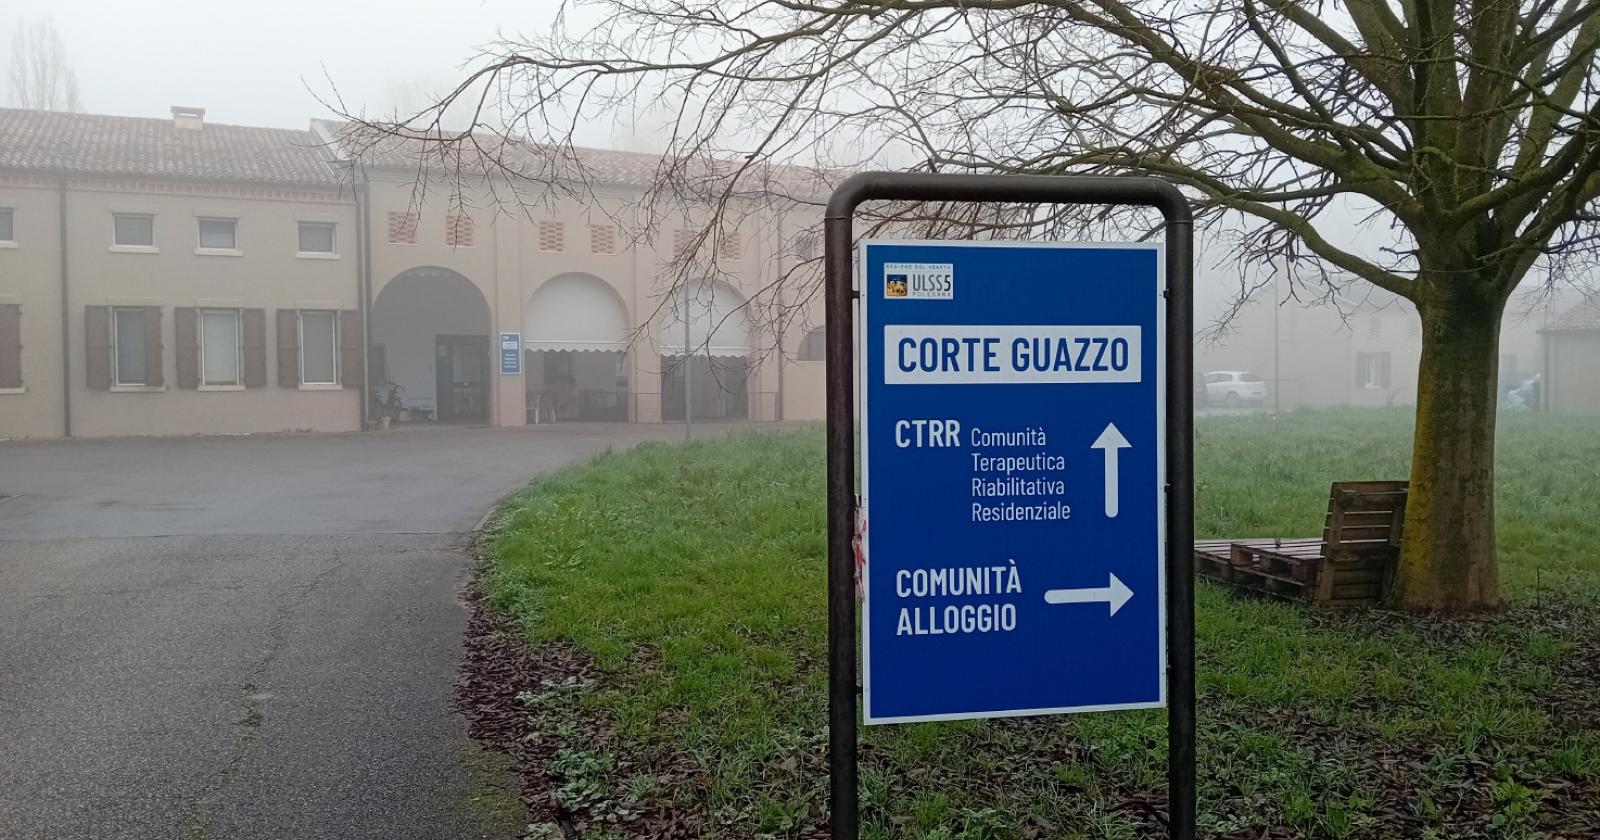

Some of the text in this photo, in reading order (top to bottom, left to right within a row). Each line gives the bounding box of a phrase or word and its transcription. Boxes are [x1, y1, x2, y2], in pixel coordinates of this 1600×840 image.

[912, 273, 951, 292] ULSS5
[898, 336, 1129, 373] CORTE GUAZZO
[895, 419, 1046, 448] CTRR Comunità
[971, 452, 1065, 475] Terapeutica
[972, 477, 1065, 497] Riabilitativa
[972, 501, 1071, 522] Residenziale
[896, 558, 1022, 598] COMUNITÀ
[896, 602, 1016, 636] ALLOGGIO
